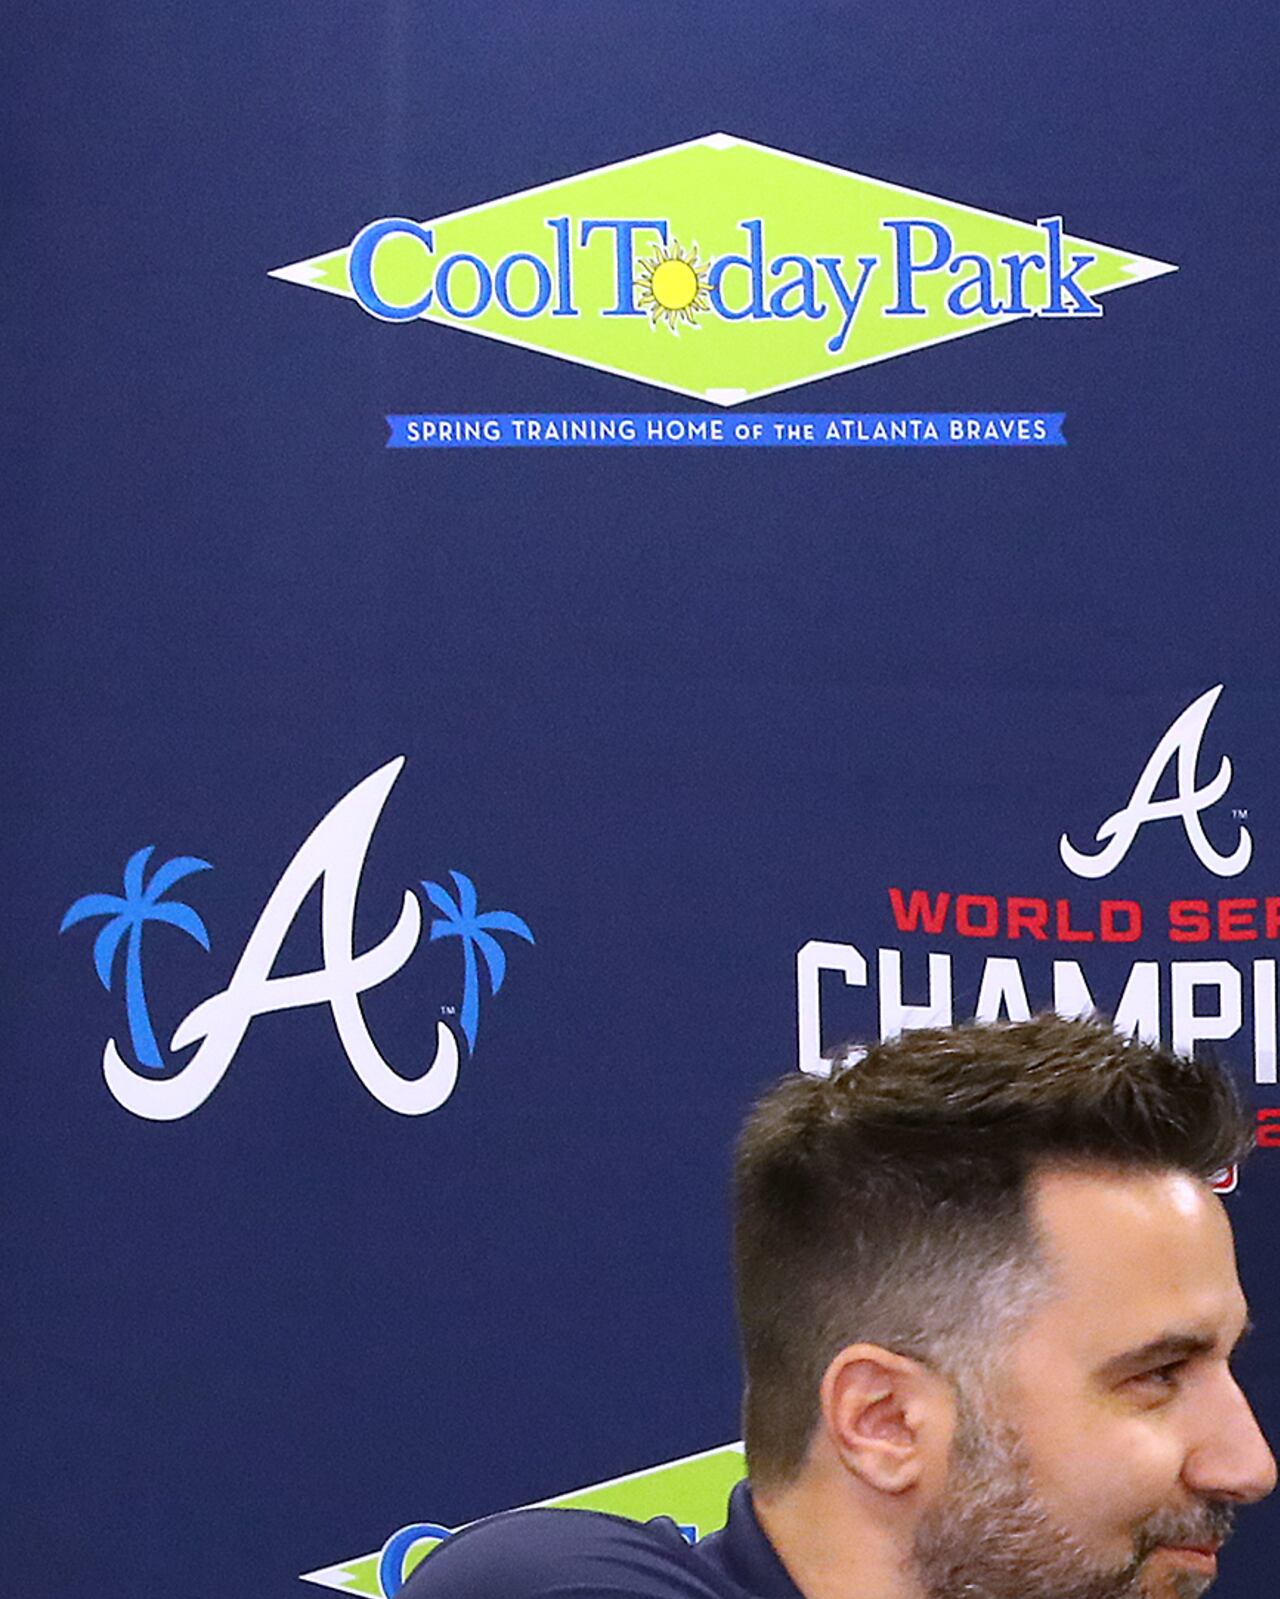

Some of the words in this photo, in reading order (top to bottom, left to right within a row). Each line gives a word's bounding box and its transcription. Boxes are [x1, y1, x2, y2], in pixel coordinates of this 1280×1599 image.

[883, 217, 1103, 317] Park
[407, 420, 501, 442] SPRING
[511, 420, 636, 441] TRAINING
[647, 419, 724, 441] HOME
[735, 424, 763, 440] OF
[773, 424, 814, 440] THE
[825, 419, 939, 441] ATLANTA
[950, 419, 1046, 441] BRAVES
[1060, 684, 1252, 878] A
[103, 755, 459, 1121] A
[888, 887, 1143, 943] WORLD
